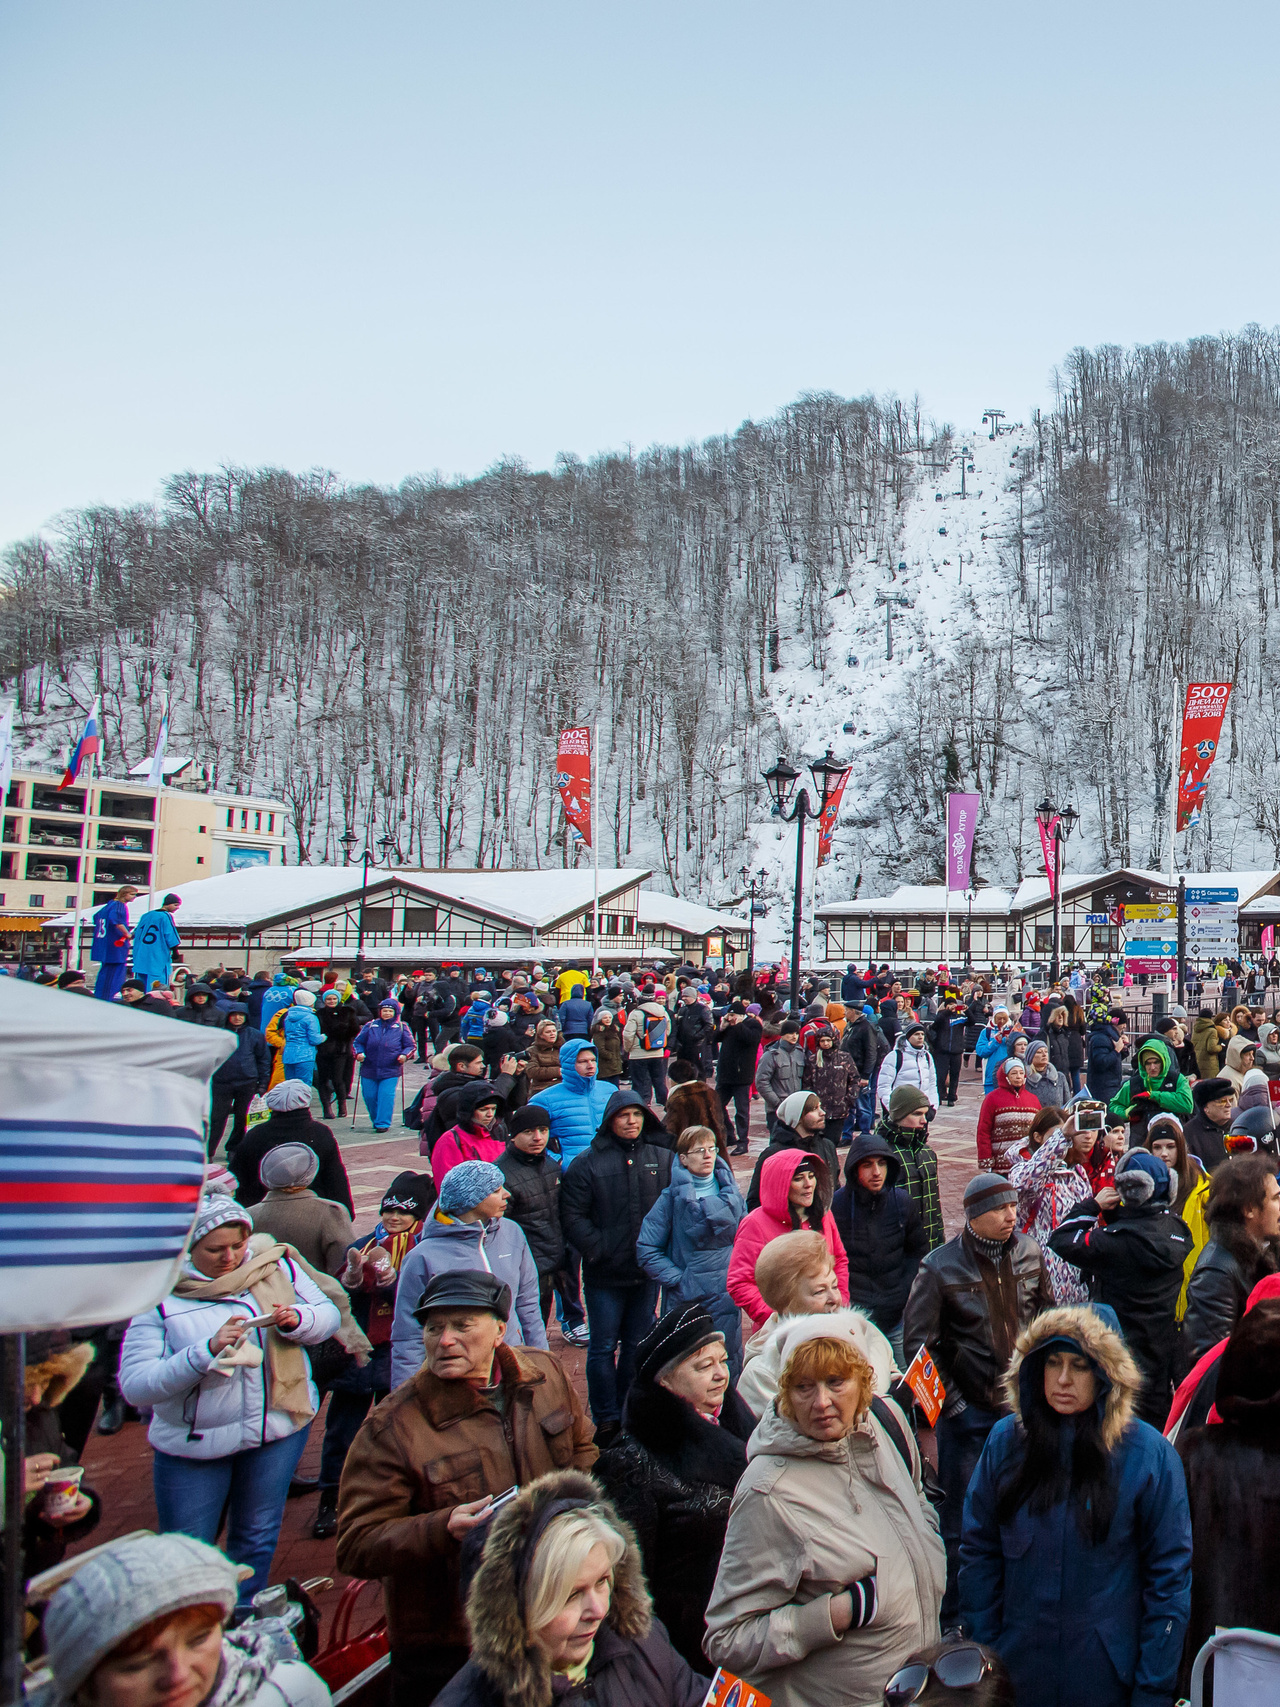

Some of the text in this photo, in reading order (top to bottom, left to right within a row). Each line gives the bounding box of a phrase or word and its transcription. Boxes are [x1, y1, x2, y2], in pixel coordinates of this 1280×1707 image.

[1189, 686, 1227, 699] 500
[1185, 712, 1201, 720] FIFA
[957, 809, 967, 874] РОЗА ХУТОР
[1086, 914, 1108, 924] РОЗА
[140, 924, 159, 945] 16
